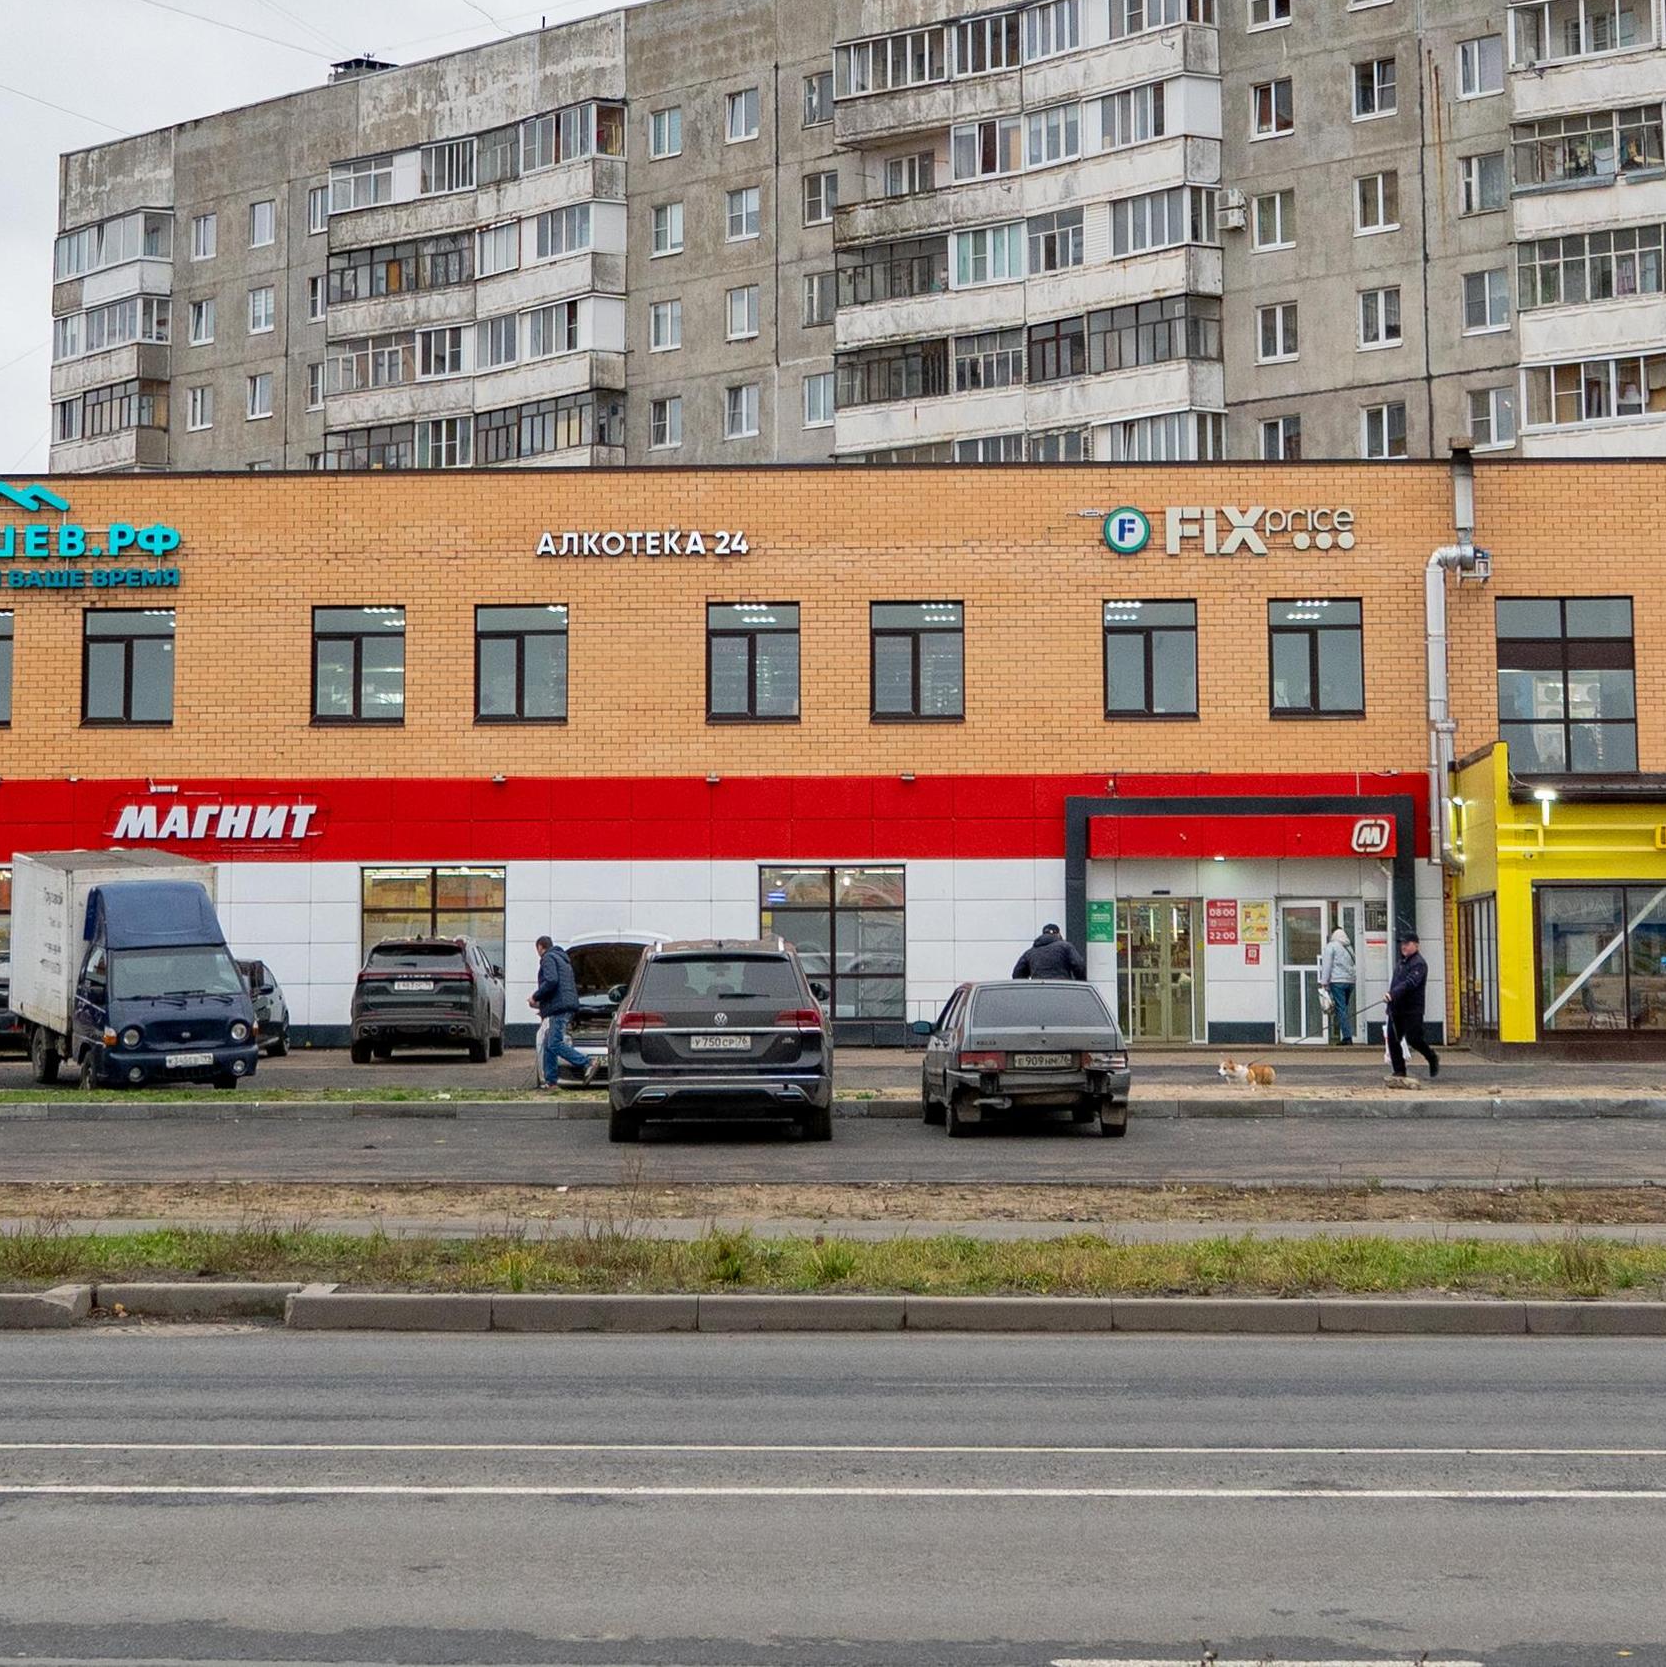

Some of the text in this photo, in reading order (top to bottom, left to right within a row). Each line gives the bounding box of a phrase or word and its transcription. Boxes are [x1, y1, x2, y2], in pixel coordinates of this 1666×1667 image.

[1265, 508, 1354, 537] price
[536, 531, 749, 556] АЛКОТЕКА 24
[8, 569, 84, 589] ВАШЕ
[92, 568, 181, 588] ВРЕМЯ
[113, 805, 317, 839] МАГНИТ
